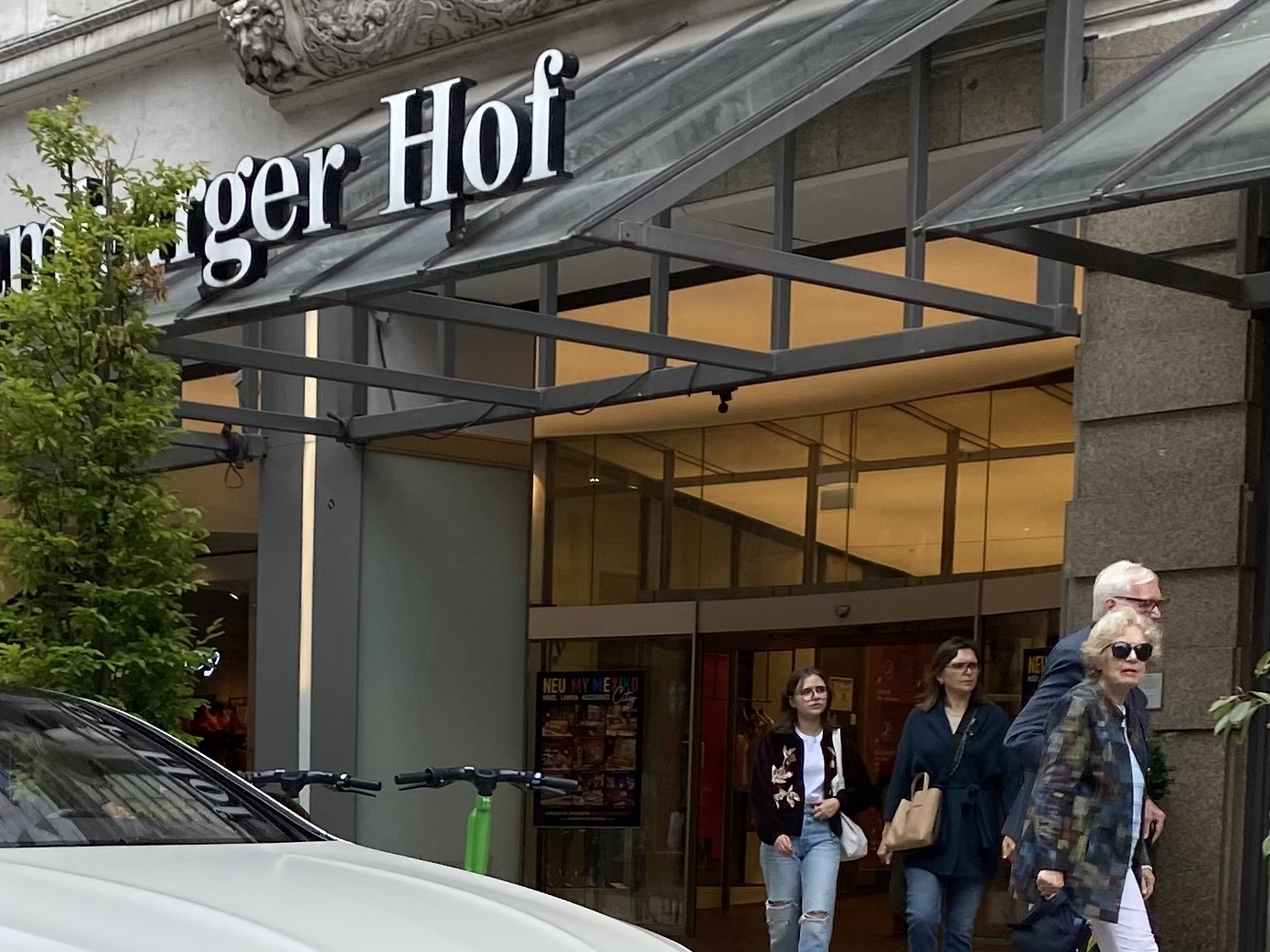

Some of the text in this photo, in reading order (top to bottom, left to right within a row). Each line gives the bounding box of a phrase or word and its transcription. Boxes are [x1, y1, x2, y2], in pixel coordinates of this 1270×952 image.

[379, 48, 577, 216] Hof
[543, 678, 566, 693] NEU
[571, 678, 589, 693] MY
